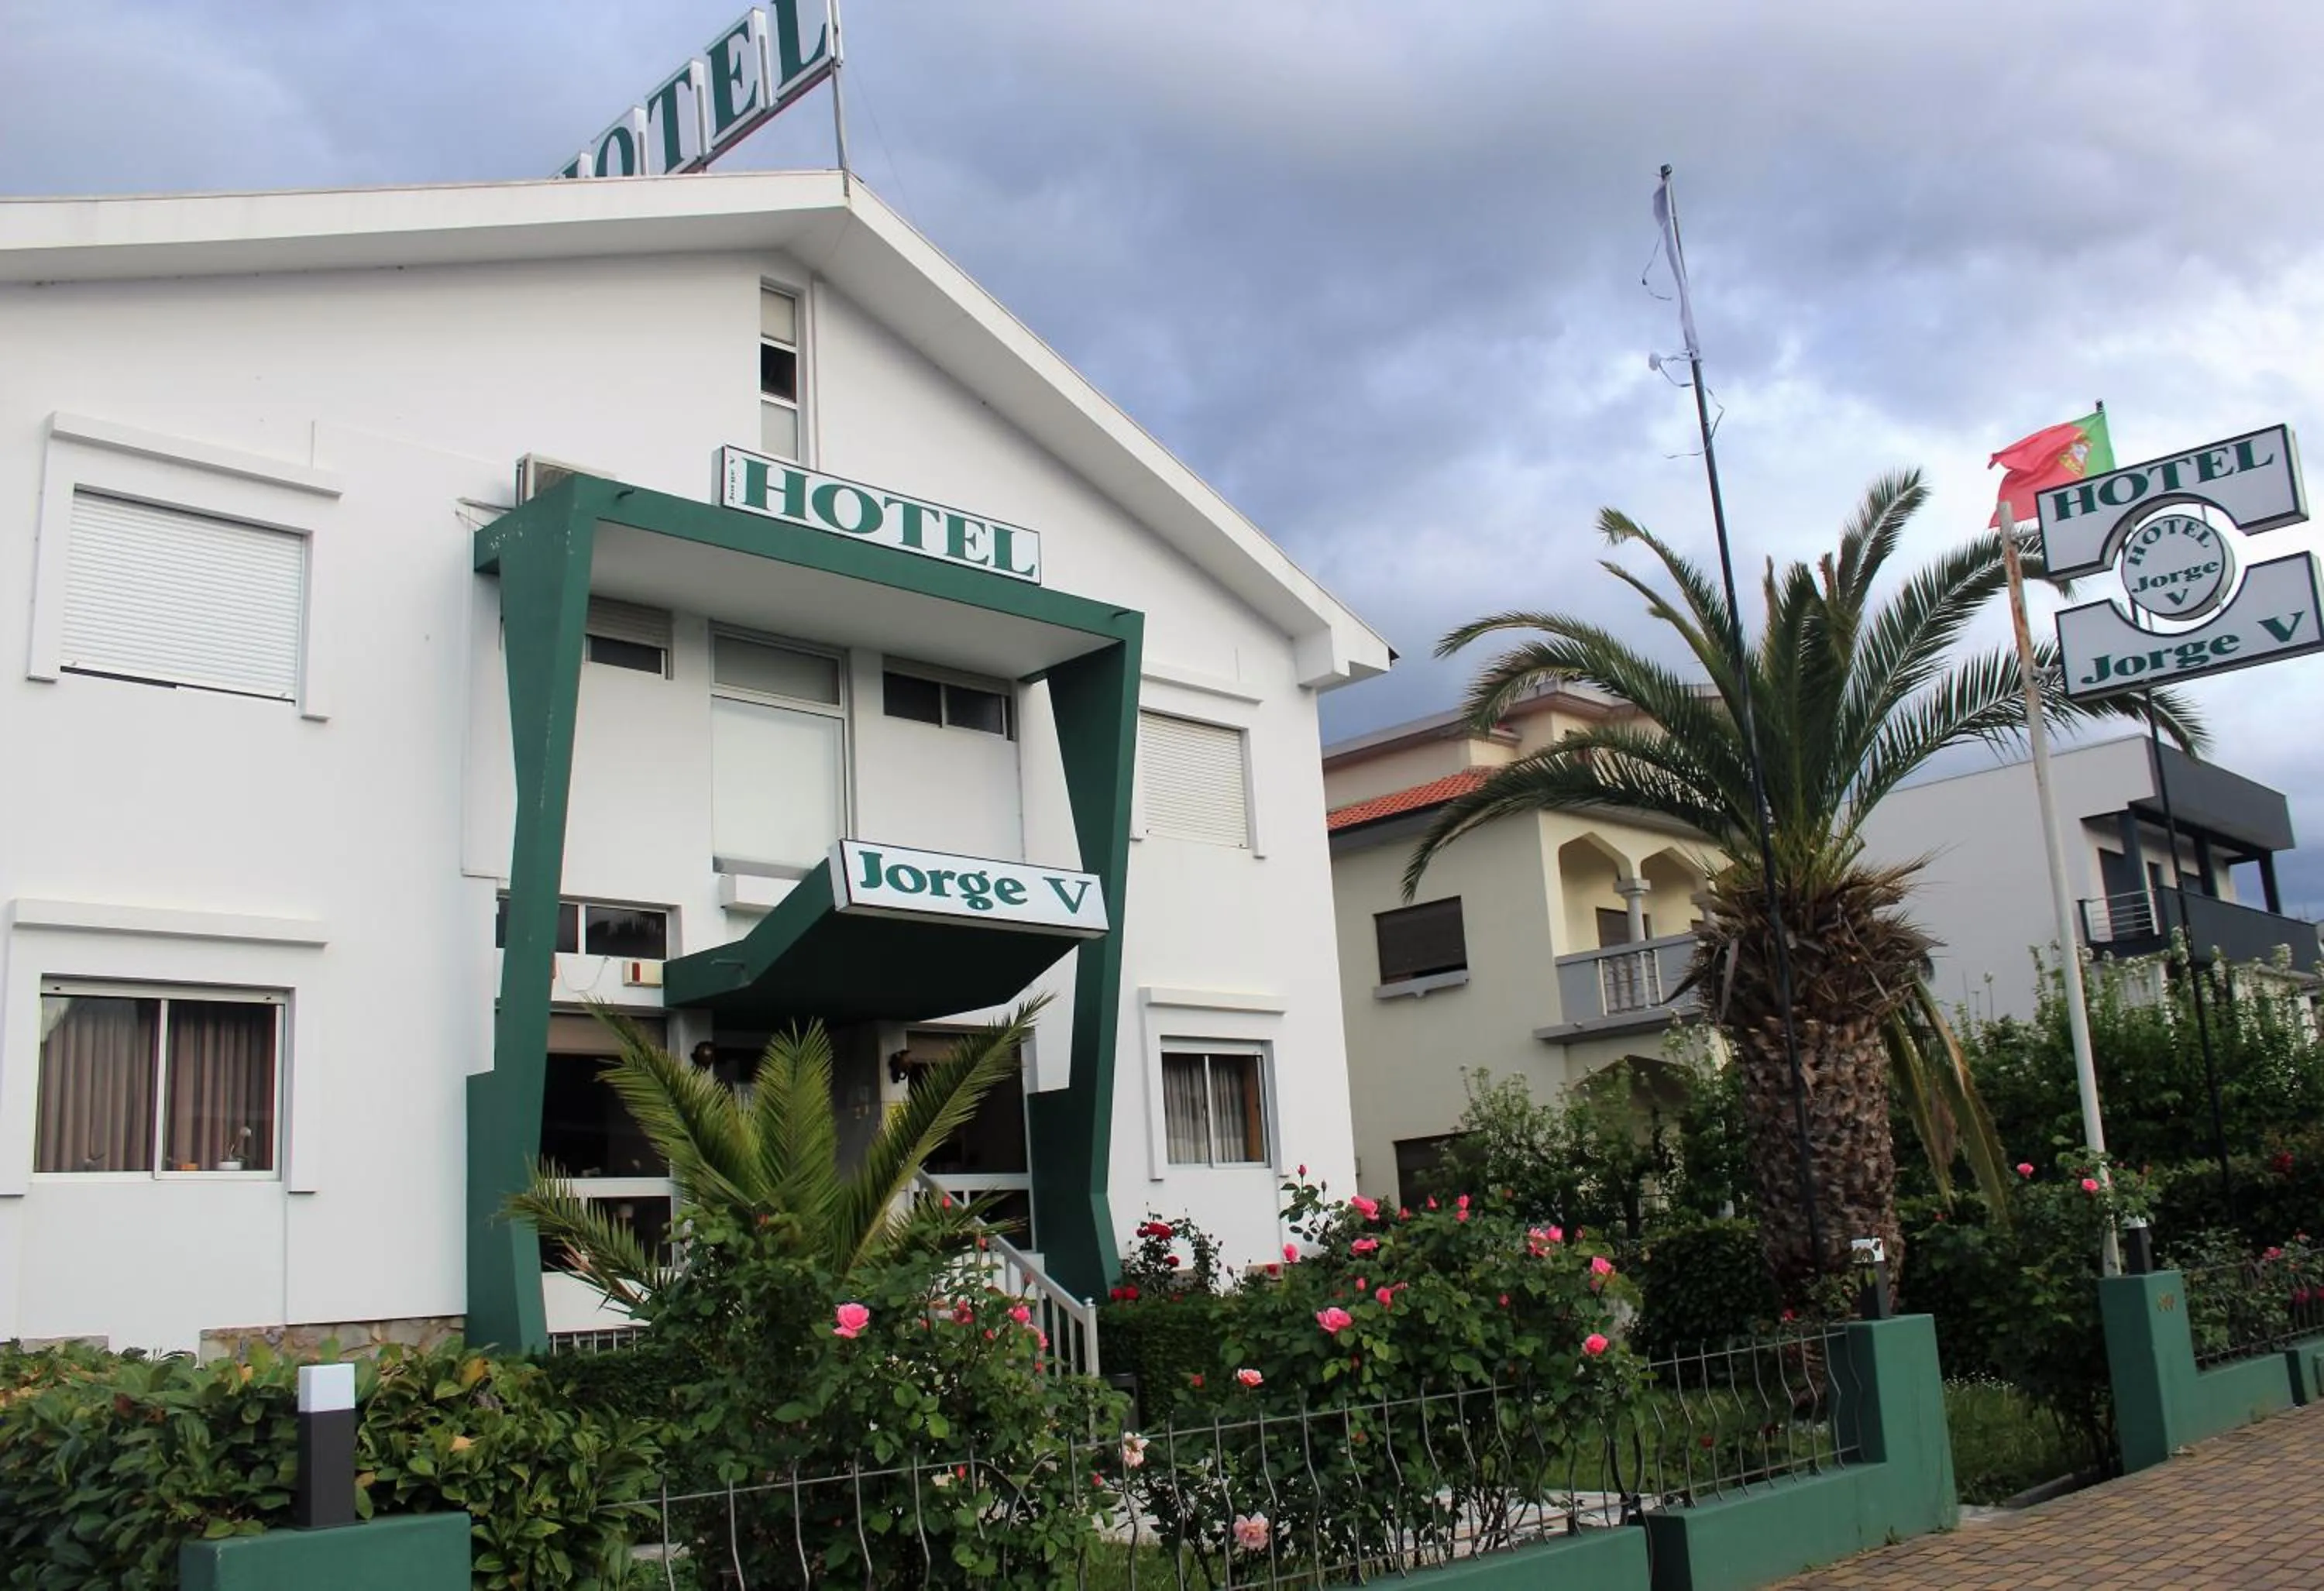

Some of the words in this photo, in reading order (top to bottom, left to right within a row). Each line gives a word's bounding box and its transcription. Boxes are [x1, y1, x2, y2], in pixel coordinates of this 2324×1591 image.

[561, 0, 827, 178] OTEL
[2053, 440, 2274, 522] HOTEL
[742, 458, 1036, 577] HOTEL
[2128, 518, 2210, 566] HOTEL
[2131, 560, 2219, 593] Jorge
[2165, 589, 2188, 607] V
[2081, 633, 2240, 685] Jorge
[2257, 610, 2305, 643] V
[858, 850, 1029, 911] Jorge
[1043, 877, 1092, 914] V
